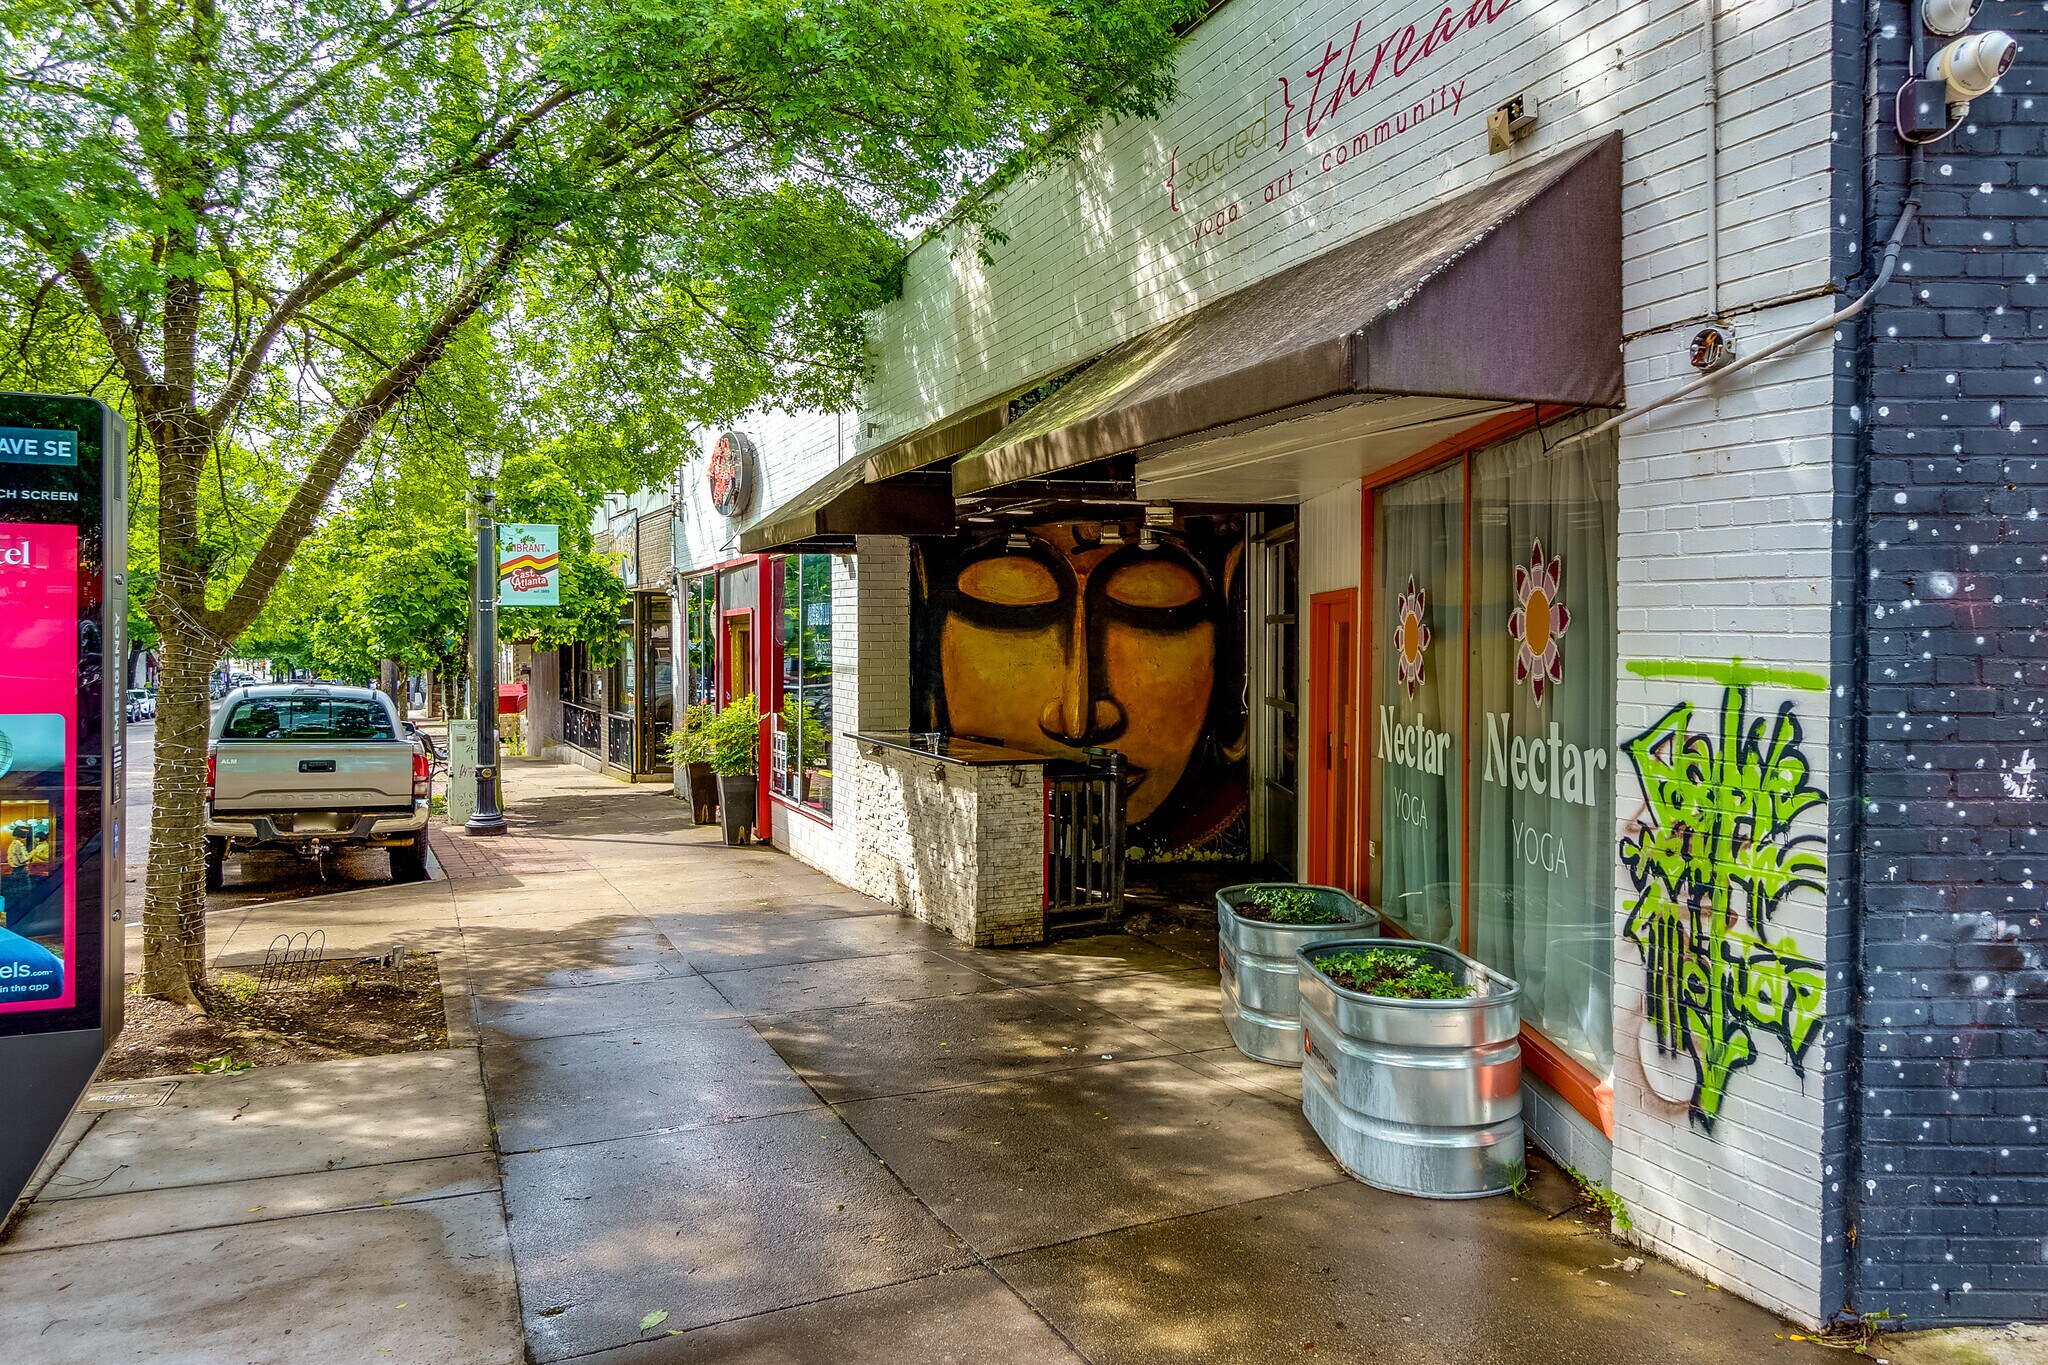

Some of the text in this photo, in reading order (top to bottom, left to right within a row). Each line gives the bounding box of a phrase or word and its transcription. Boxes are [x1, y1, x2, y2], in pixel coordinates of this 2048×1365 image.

[1195, 81, 1465, 248] yoga art community
[0, 437, 72, 457] AVE SE
[21, 489, 79, 502] SCREEN
[0, 540, 30, 565] el
[510, 575, 547, 589] Atlanta
[513, 568, 536, 579] East
[1378, 705, 1451, 776] Nectar
[1484, 712, 1607, 807] Nectar
[260, 793, 374, 801] TACOMA
[1394, 786, 1428, 830] YOGA
[1512, 818, 1569, 879] YOGA
[11, 984, 28, 993] the
[28, 983, 50, 992] app
